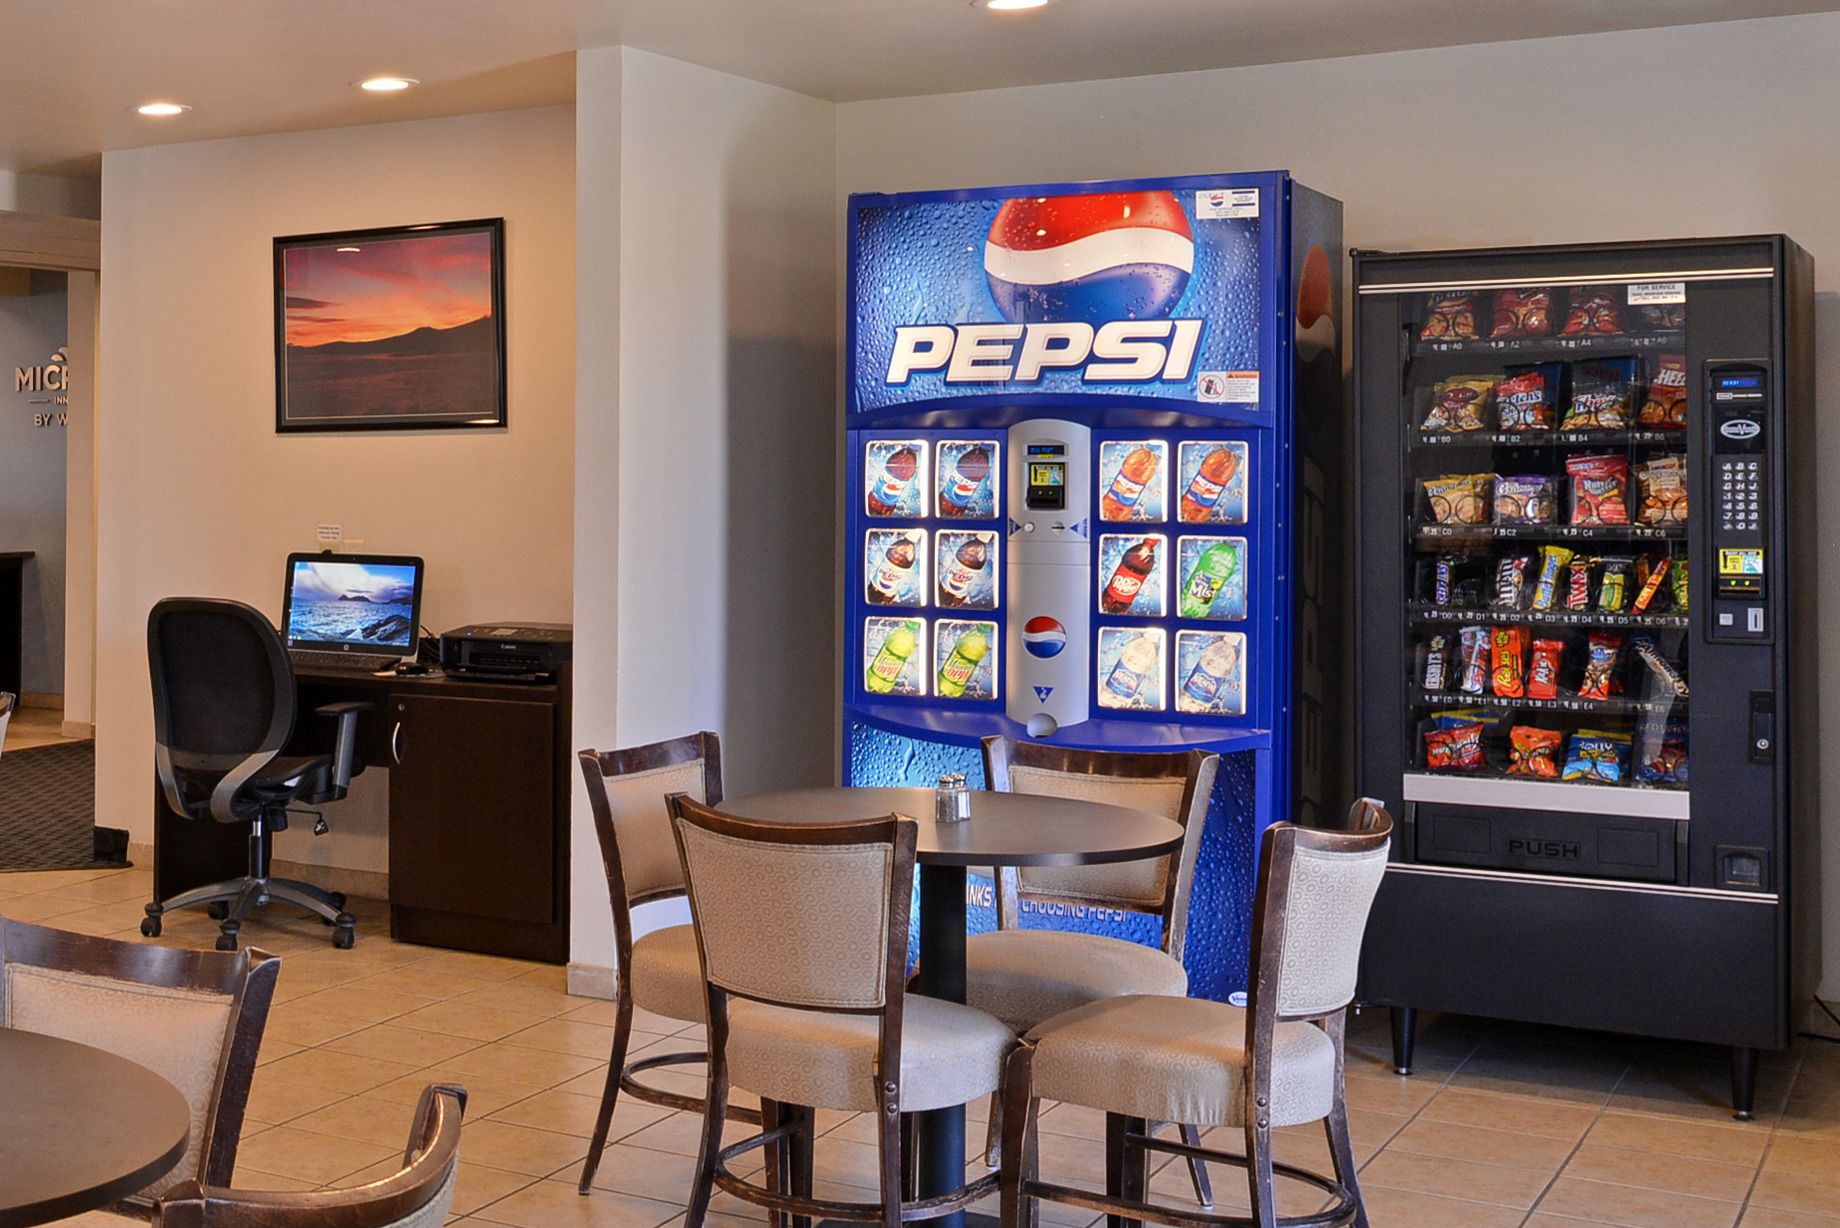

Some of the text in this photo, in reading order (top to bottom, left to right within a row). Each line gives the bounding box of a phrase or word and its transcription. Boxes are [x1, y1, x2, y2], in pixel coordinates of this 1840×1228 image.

[885, 319, 1202, 384] PEPSI
[34, 413, 51, 426] BY
[1506, 528, 1517, 536] C2
[1582, 528, 1593, 537] C4
[1302, 454, 1324, 828] EPSI
[1508, 839, 1578, 858] PUSH
[966, 884, 993, 908] NKS
